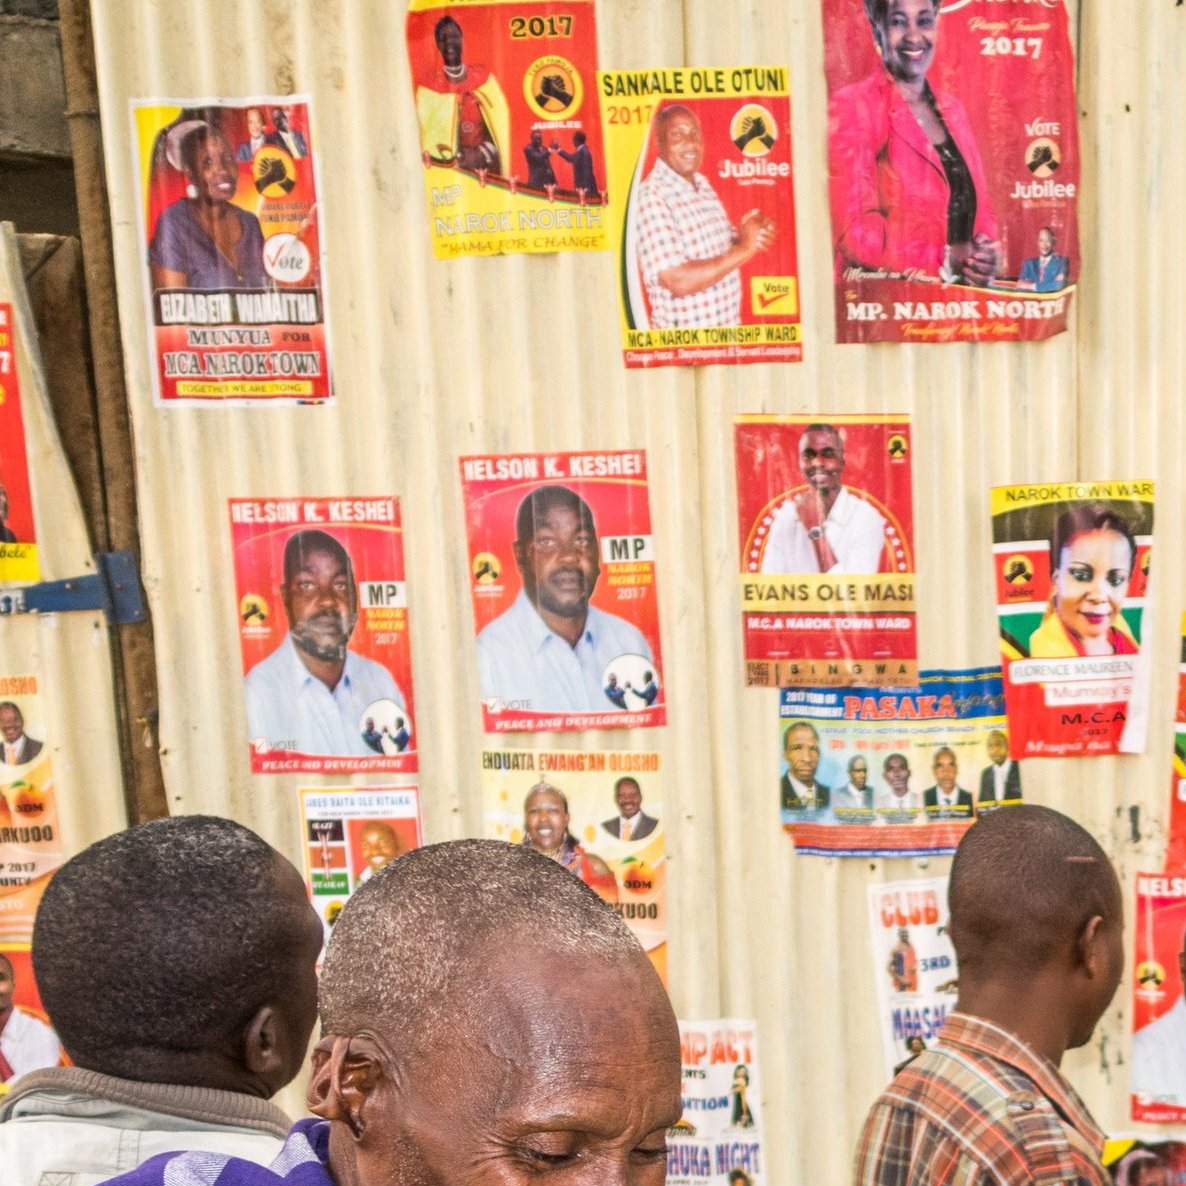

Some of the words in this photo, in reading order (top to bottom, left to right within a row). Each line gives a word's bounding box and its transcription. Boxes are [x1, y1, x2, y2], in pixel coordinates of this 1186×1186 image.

[510, 15, 572, 39] 2017
[979, 38, 1041, 59] 2017
[603, 71, 684, 97] SANKALE
[690, 70, 726, 95] OLE
[731, 69, 786, 93] OTUNI
[607, 104, 653, 125] 2017
[1024, 118, 1060, 137] VOTE
[718, 158, 792, 179] Jubilee
[431, 184, 461, 207] MP
[1010, 181, 1075, 204] Jubilee
[518, 207, 604, 231] NORTH
[763, 282, 791, 294] Vote
[236, 292, 319, 324] WAMAITHA
[845, 302, 887, 321] MP.
[893, 302, 980, 320] NAROK
[188, 328, 272, 346] MUNYUA
[281, 331, 312, 342] FOR
[628, 331, 654, 348] MCA
[659, 328, 701, 345] NAROK
[702, 327, 760, 344] TOWNSHIP
[765, 326, 796, 341] WARD
[232, 383, 246, 393] WE
[248, 383, 267, 393] ARE
[462, 457, 540, 481] NELSON
[543, 456, 566, 479] K.
[569, 453, 642, 477] KESHEI
[1004, 485, 1062, 503] NAROK
[1067, 482, 1113, 501] TOWN
[231, 501, 299, 523] NELSON
[303, 501, 324, 523] K.
[327, 499, 396, 522] KESHEI
[609, 536, 646, 561] MP
[366, 583, 399, 606] MP
[615, 587, 648, 601] 2017
[743, 582, 811, 602] EVANS
[816, 581, 858, 602] OLE
[862, 582, 916, 602] MASI
[1004, 587, 1035, 600] Jubilee
[1012, 664, 1070, 683] FLORENCE
[1074, 660, 1134, 678] MAUREEN
[501, 698, 533, 711] VOTE
[843, 694, 957, 721] PASAKA
[496, 716, 534, 731] PEACE
[537, 715, 562, 729] AND
[566, 711, 653, 728] DEVELOPMENT
[1060, 711, 1128, 727] M.C.A
[269, 739, 300, 752] VOTE
[261, 757, 300, 771] PEACE
[608, 753, 660, 771] OLOSHO
[881, 890, 941, 928] CLUB
[920, 954, 952, 973] 3RD
[715, 1141, 760, 1176] NIGHT
